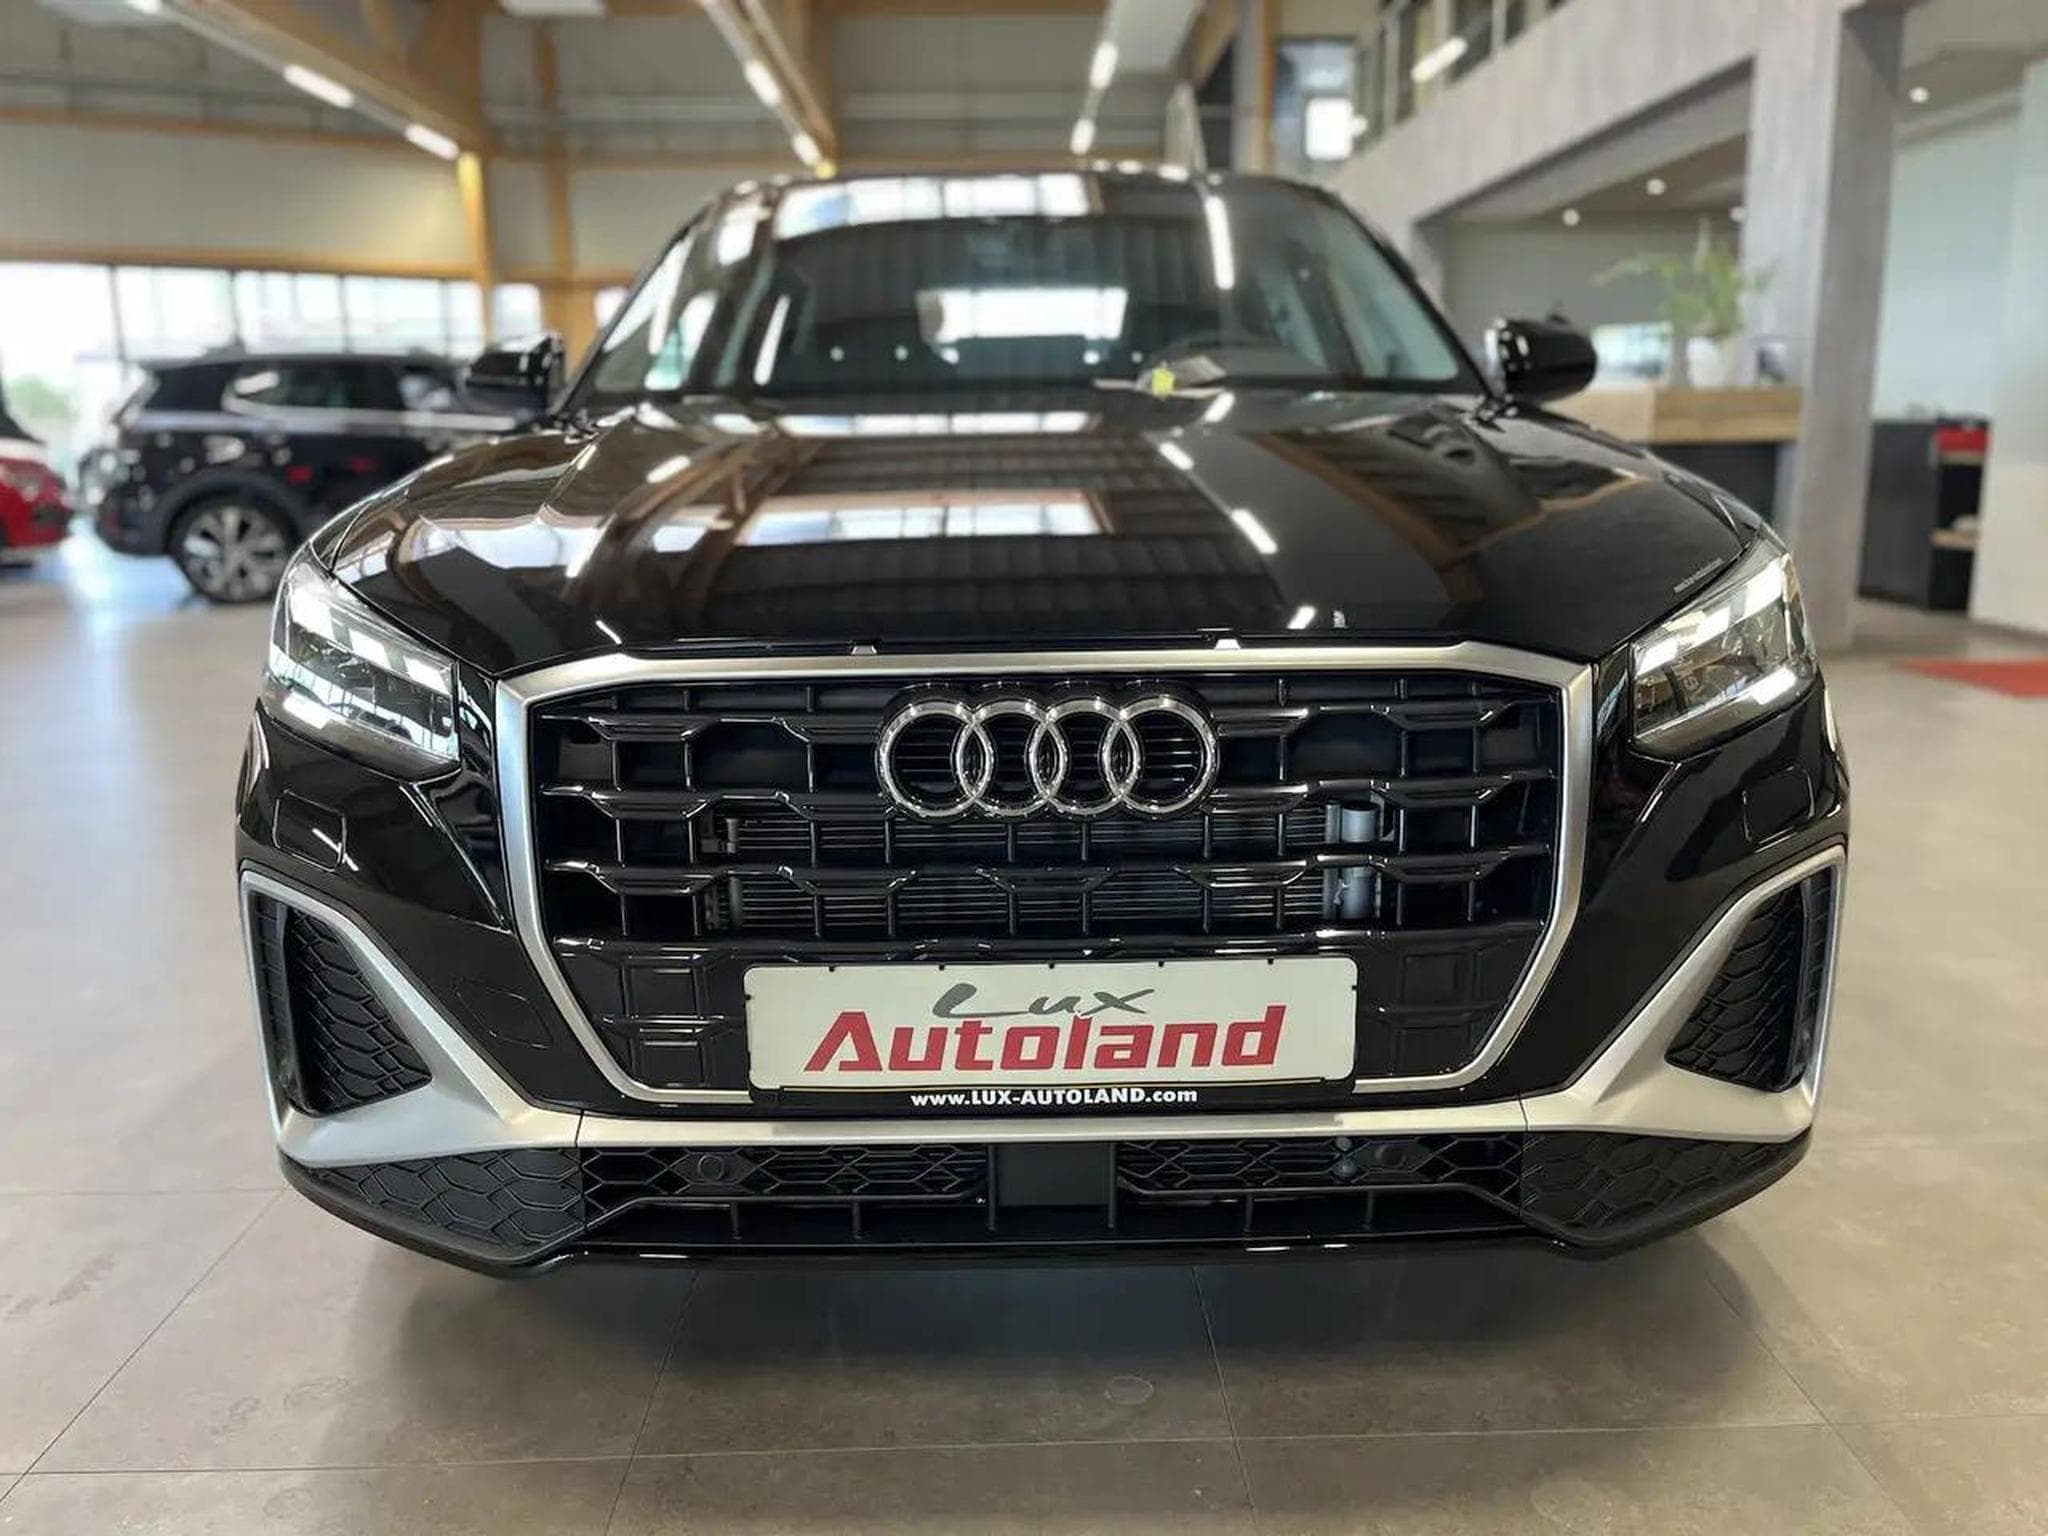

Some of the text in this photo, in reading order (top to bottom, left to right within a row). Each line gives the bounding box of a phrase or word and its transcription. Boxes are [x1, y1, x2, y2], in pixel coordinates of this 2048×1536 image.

[932, 983, 1155, 1018] Lux
[804, 1004, 1286, 1072] Autoland
[910, 1087, 1198, 1107] www.LUX-AUTOLAND.com
